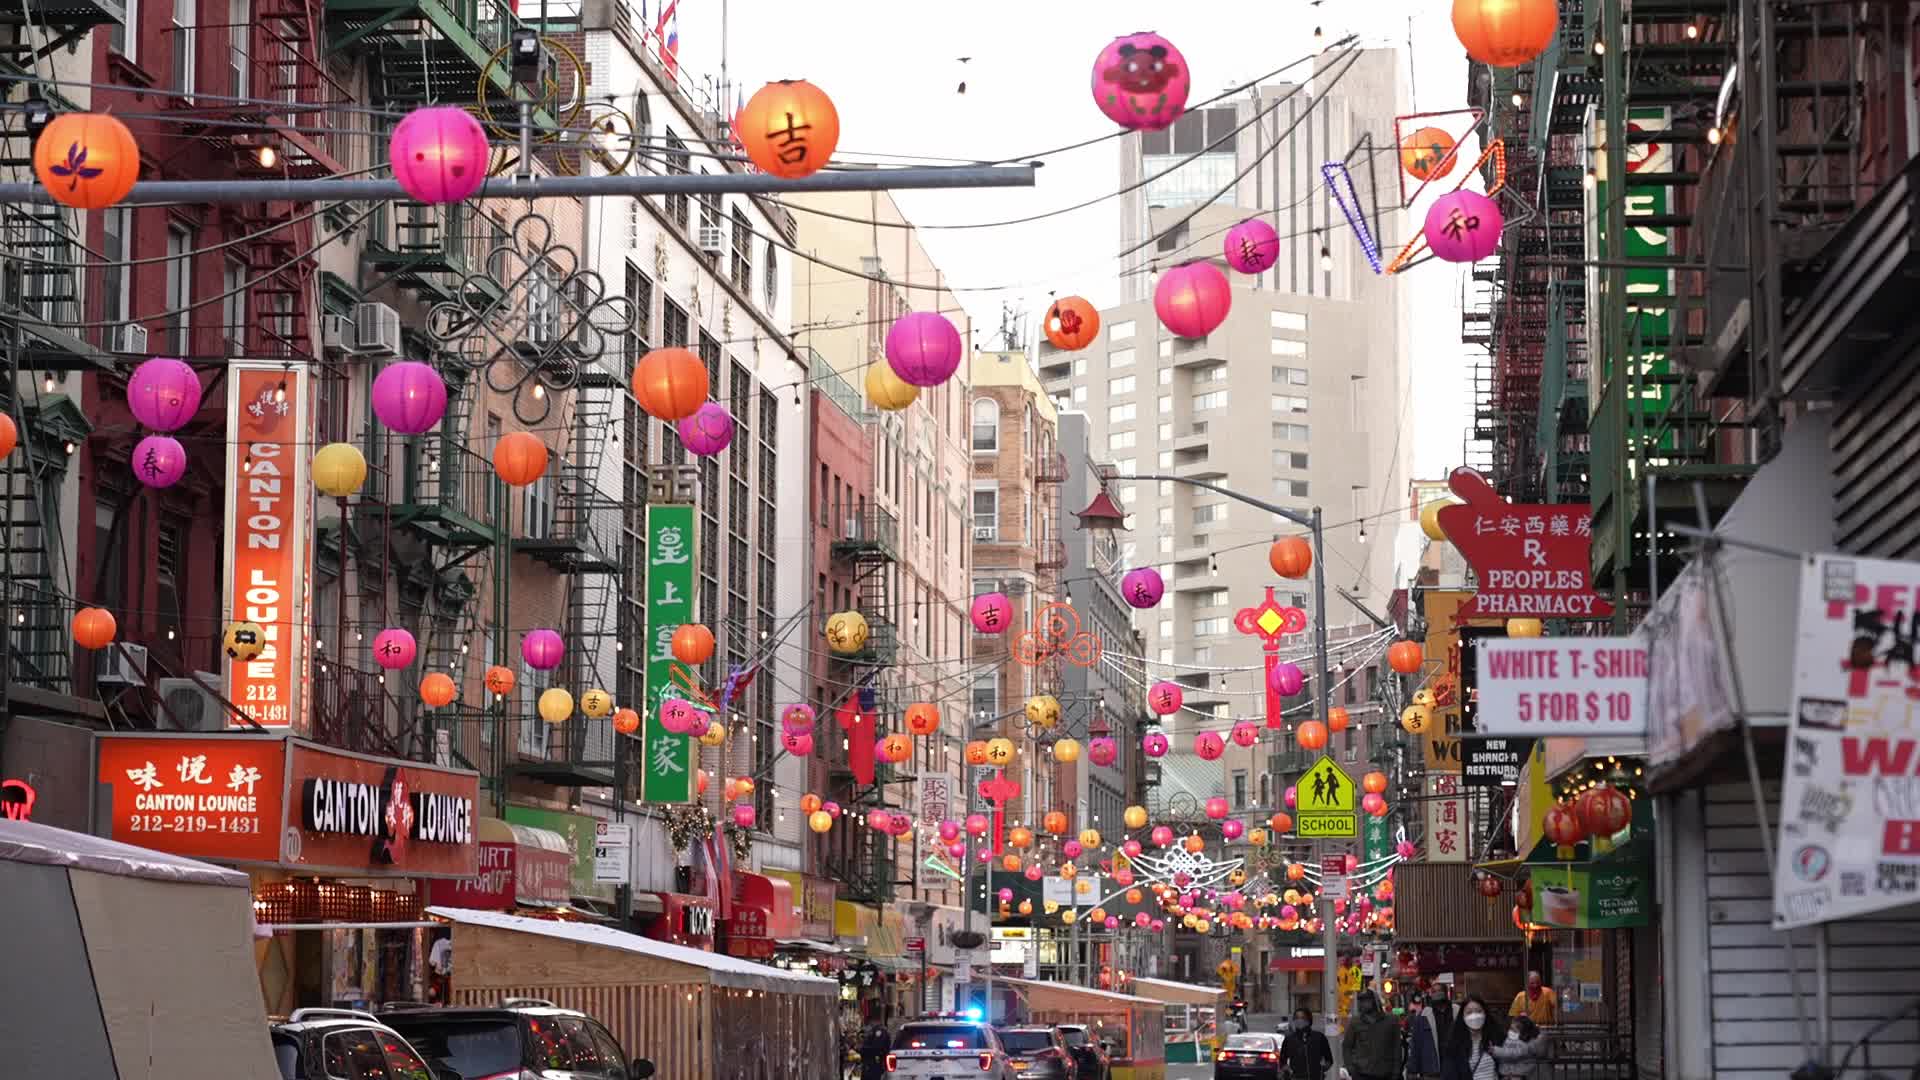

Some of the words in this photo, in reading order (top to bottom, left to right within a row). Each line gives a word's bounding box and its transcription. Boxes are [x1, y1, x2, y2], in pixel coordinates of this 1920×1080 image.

[766, 112, 811, 164] 吉
[1440, 207, 1480, 242] 和
[143, 447, 165, 480] 春
[247, 443, 281, 549] CANTON
[1475, 514, 1592, 536] 仁安西藥房
[1488, 570, 1584, 589] PEOPLES
[1476, 593, 1596, 613] PHARMACY
[981, 603, 1000, 627] 吉
[380, 640, 401, 657] 和
[1488, 649, 1559, 679] WHITE
[246, 685, 277, 701] 212
[1158, 689, 1172, 708] 吉
[587, 695, 600, 711] 吉
[1518, 692, 1532, 721] 5
[1538, 692, 1579, 721] FOR
[1408, 712, 1422, 728] 吉
[989, 745, 1006, 760] 和
[1486, 740, 1507, 750] NEW
[1841, 736, 1920, 777] W
[135, 794, 195, 812] CANTON
[198, 795, 257, 813] LOUNGE
[313, 777, 380, 836] CANTON
[130, 815, 261, 834] 212-219-1431
[419, 791, 473, 844] LOUNGE
[1302, 819, 1352, 831] SCHOOL
[288, 833, 299, 850] 70
